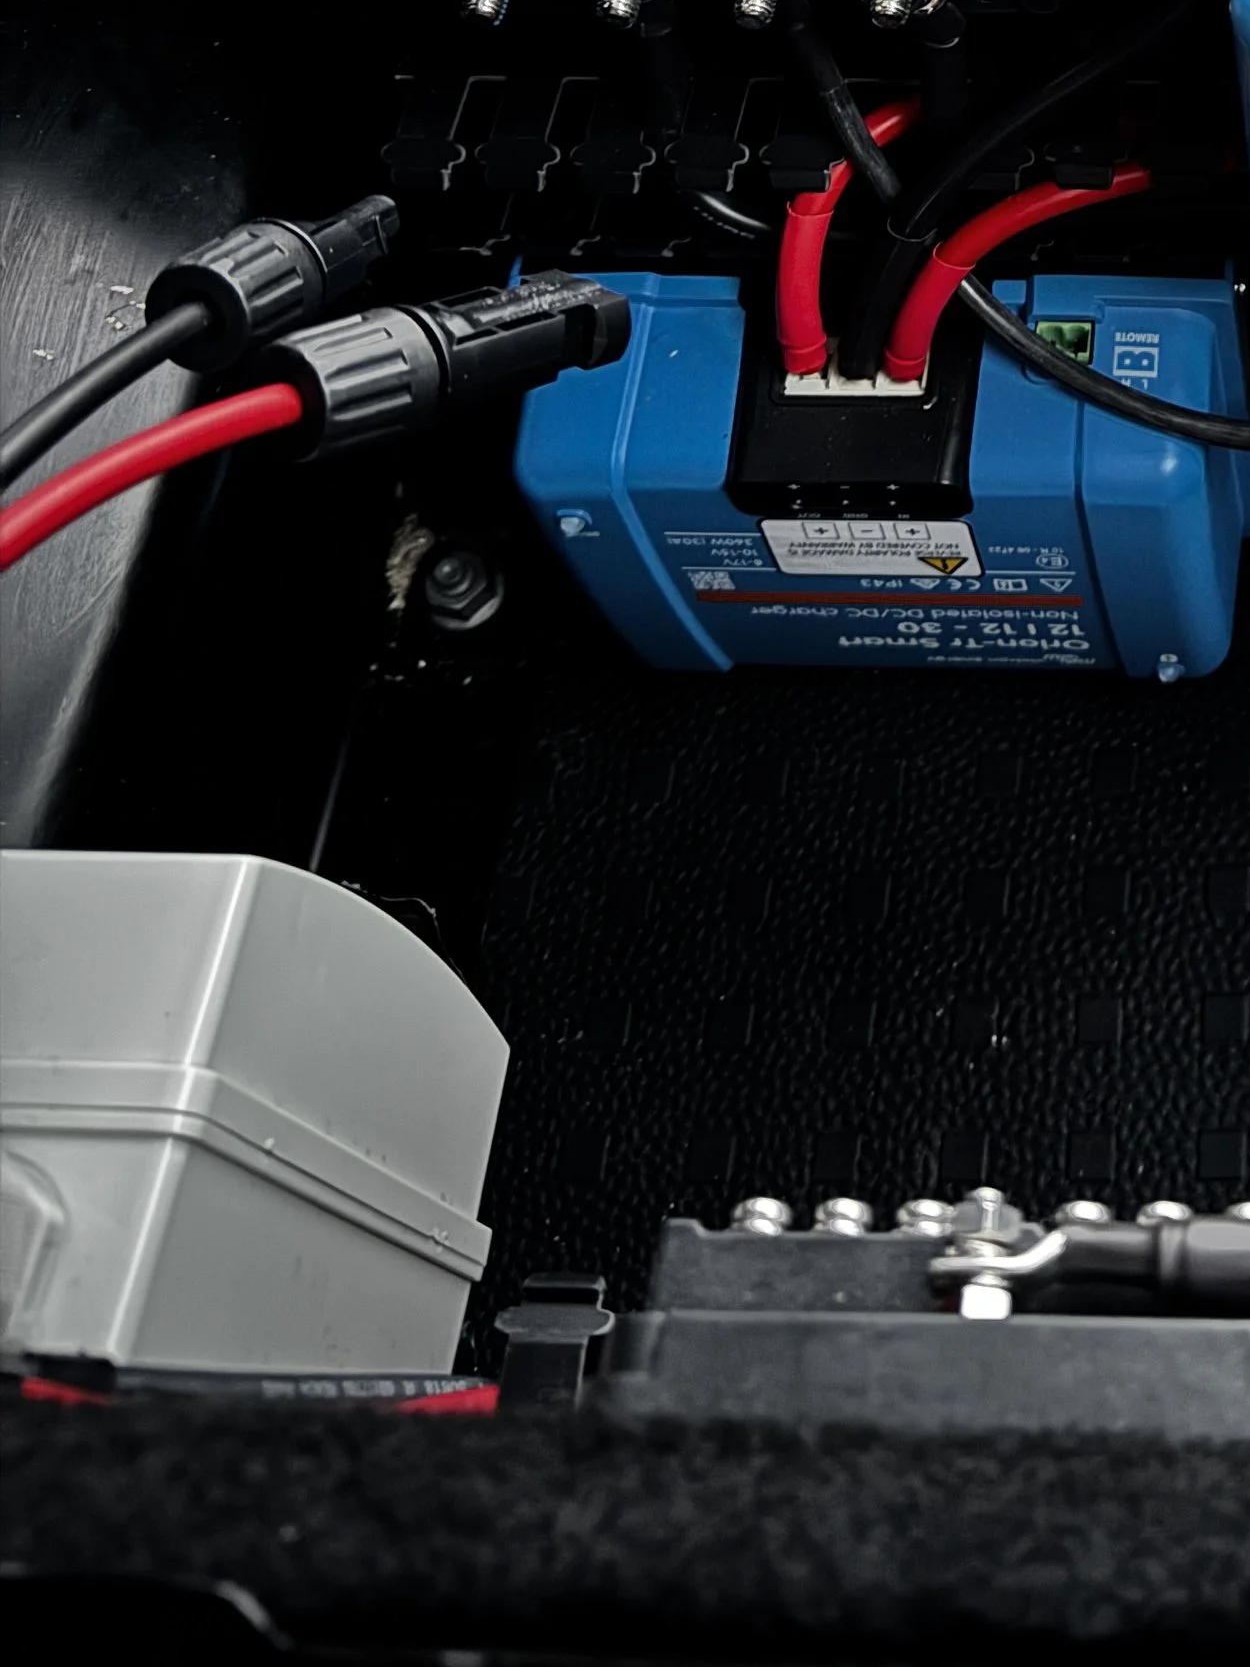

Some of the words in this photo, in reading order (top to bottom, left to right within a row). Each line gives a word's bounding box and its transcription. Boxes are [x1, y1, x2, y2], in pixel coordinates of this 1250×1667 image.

[1114, 332, 1160, 344] REMOTE
[711, 548, 759, 556] 10-15V
[859, 578, 903, 588] IP43
[751, 604, 839, 617] charger
[845, 607, 925, 619] DC/DC
[930, 609, 1079, 620] Non-isolated
[897, 621, 942, 634] 30
[979, 622, 1017, 635] 12
[1048, 623, 1086, 636] 12
[838, 636, 941, 649] Smart
[951, 637, 1090, 650] Orion-Tr
